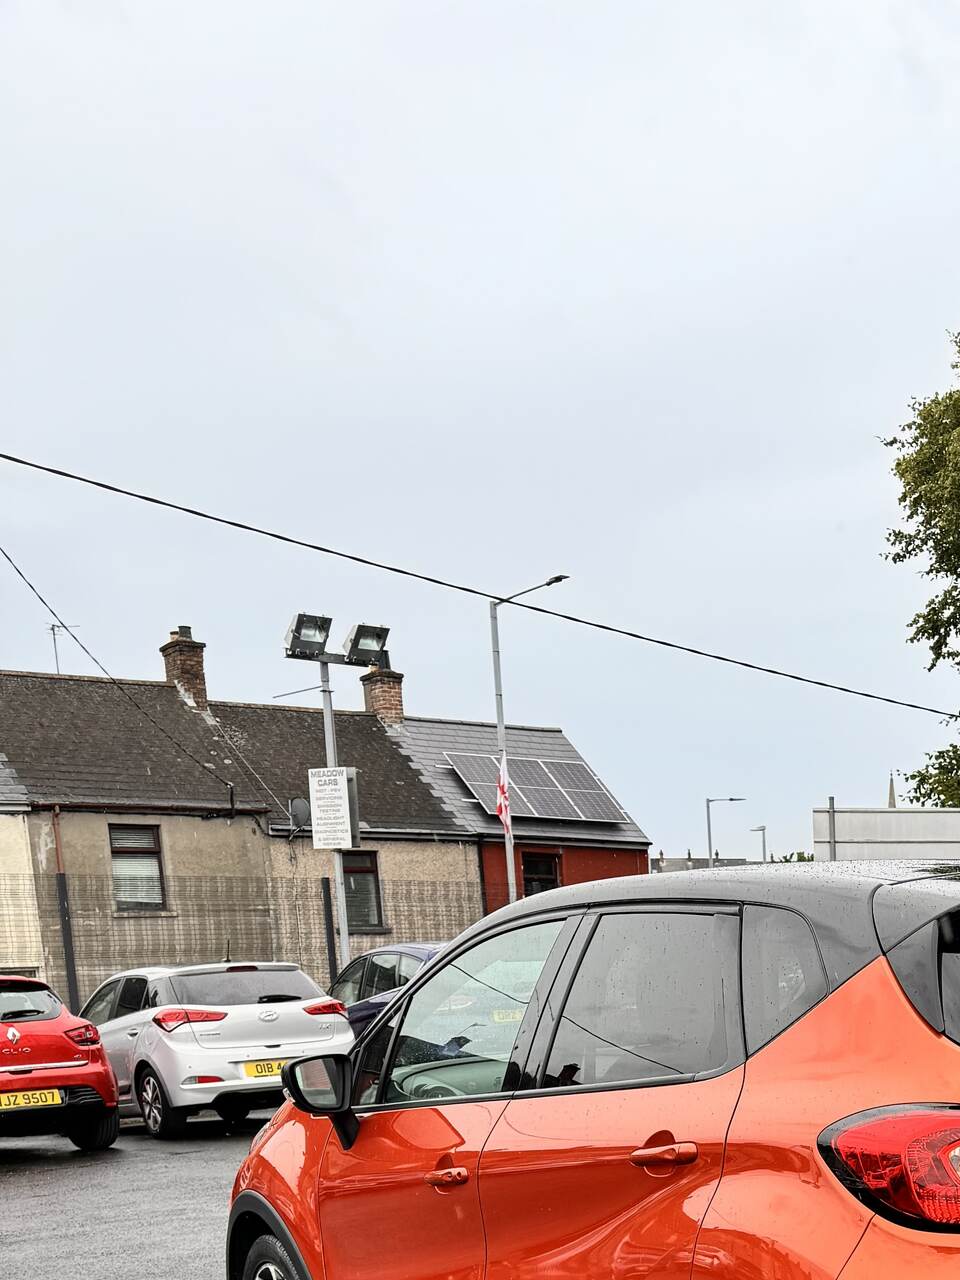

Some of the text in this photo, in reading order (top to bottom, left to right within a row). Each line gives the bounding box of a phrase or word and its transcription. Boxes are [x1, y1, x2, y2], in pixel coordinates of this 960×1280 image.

[311, 769, 344, 778] MEADOW
[317, 778, 338, 786] CARS
[2, 1047, 31, 1055] CLIO
[255, 1063, 274, 1074] OIB
[0, 1091, 55, 1108] JZ 9507
